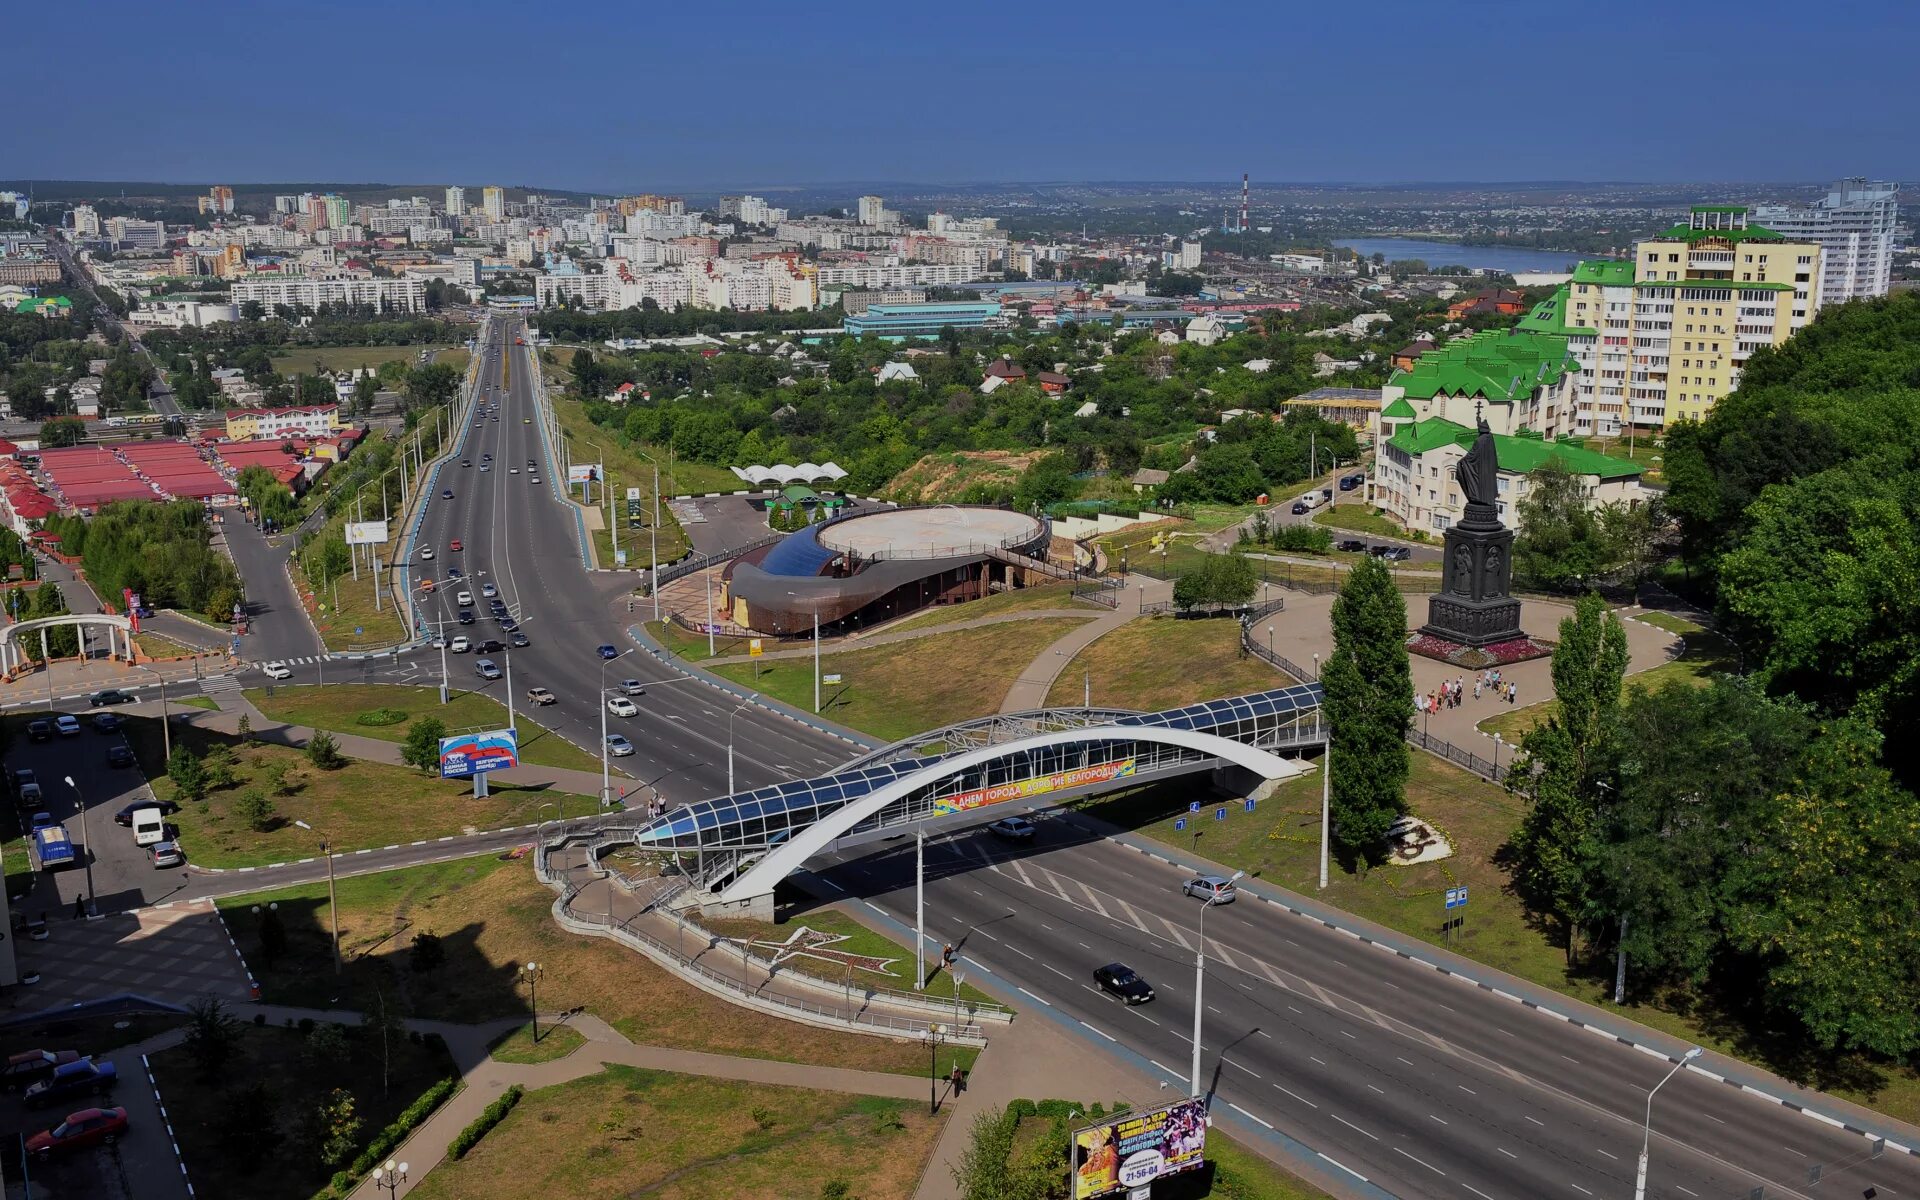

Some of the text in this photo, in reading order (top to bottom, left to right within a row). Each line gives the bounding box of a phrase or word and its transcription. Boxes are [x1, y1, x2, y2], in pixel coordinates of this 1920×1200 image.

[948, 799, 957, 808] С
[959, 793, 984, 807] ДНЕМ
[1026, 778, 1065, 793] ДОРОГИЕ
[1126, 1165, 1158, 1182] 21-56-04
